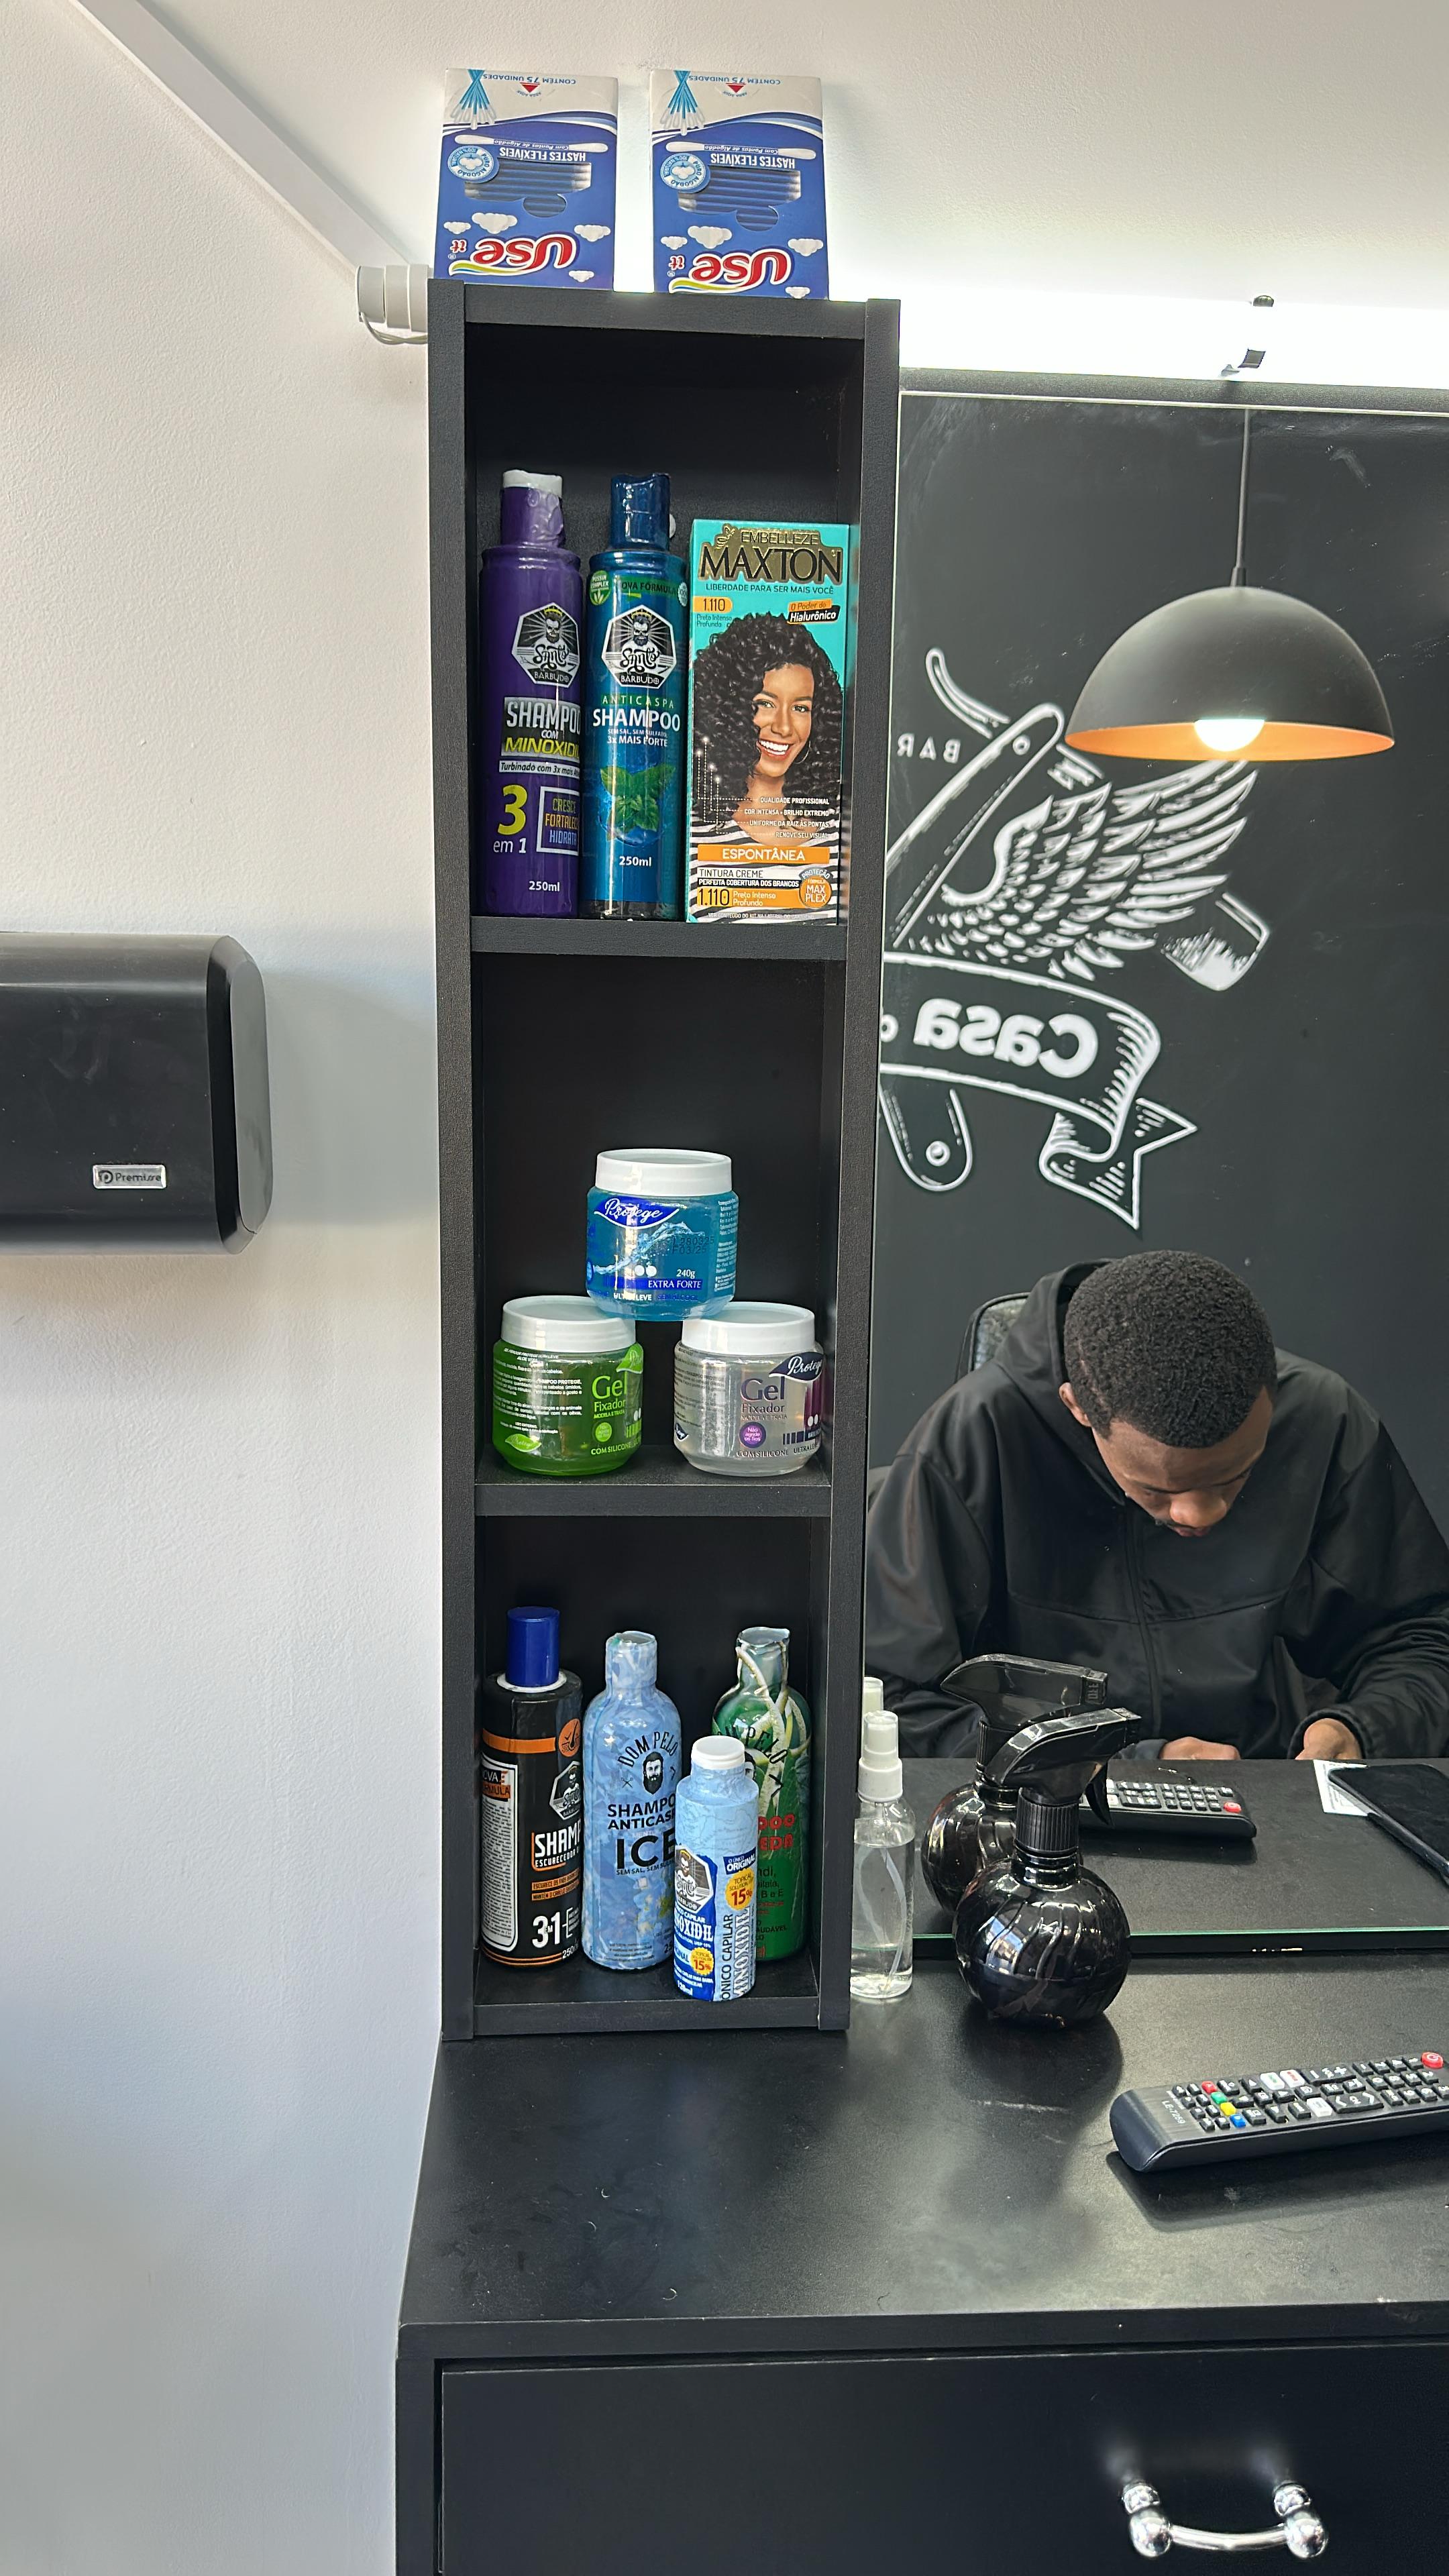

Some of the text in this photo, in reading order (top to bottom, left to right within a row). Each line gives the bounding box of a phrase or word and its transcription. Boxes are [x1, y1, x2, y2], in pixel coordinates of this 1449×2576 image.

[483, 74, 525, 82] UNIDADES
[499, 148, 586, 162] HASTES FLEXÍVEIS
[710, 154, 796, 168] HASTES FLEXÍVEIS
[451, 240, 466, 252] it
[670, 256, 684, 270] it
[741, 531, 819, 545] EMBELLEZE
[700, 545, 841, 582] MAXTON
[617, 582, 637, 590] OVA
[706, 584, 749, 592] LIBERDADE
[812, 586, 834, 594] VOCÊ
[703, 598, 726, 612] 1.110
[790, 611, 837, 623] Hialurônico
[621, 674, 659, 684] BARBUDO
[602, 695, 674, 709] ANTICASPA
[592, 708, 680, 732] SHAMPOO
[541, 730, 559, 740] COM
[607, 736, 667, 747] 3x MAIS FORTE
[500, 762, 535, 771] Turbinado
[553, 765, 560, 773] 3x
[498, 784, 528, 835] 3
[493, 838, 527, 853] em 1
[722, 847, 806, 861] ESPONTÂNEA
[619, 856, 651, 866] 250ml
[700, 869, 763, 878] TINTURA CREME
[529, 881, 560, 892] 250ml
[698, 878, 726, 886] PERFEITA
[726, 879, 759, 887] COBERTURA
[733, 890, 751, 898] Preto
[806, 885, 826, 894] MAX
[698, 888, 730, 906] 1.110
[805, 893, 826, 903] PLEX
[115, 1172, 161, 1182] Premisse
[676, 1269, 696, 1279] 240g
[648, 1280, 702, 1289] EXTRA FORTE
[592, 1371, 627, 1399] Gel
[741, 1376, 786, 1401] Gel
[594, 1398, 626, 1413] Fixador
[741, 1402, 785, 1413] Fixador
[591, 1446, 607, 1455] COM
[737, 1449, 789, 1458] COM SILICONE
[794, 1446, 809, 1454] ULTRA
[618, 1731, 678, 1768] DOM PELO
[745, 1727, 788, 1764] PELO
[608, 1792, 676, 1817] SHAMPO
[616, 1827, 676, 1870] ICE
[532, 1915, 549, 1948] 3
[551, 1911, 560, 1945] 1
[720, 1914, 733, 2000] ÔNICO CAPILAR
[733, 1907, 750, 1996] MINOXIDIL
[694, 1959, 711, 1971] 15%
